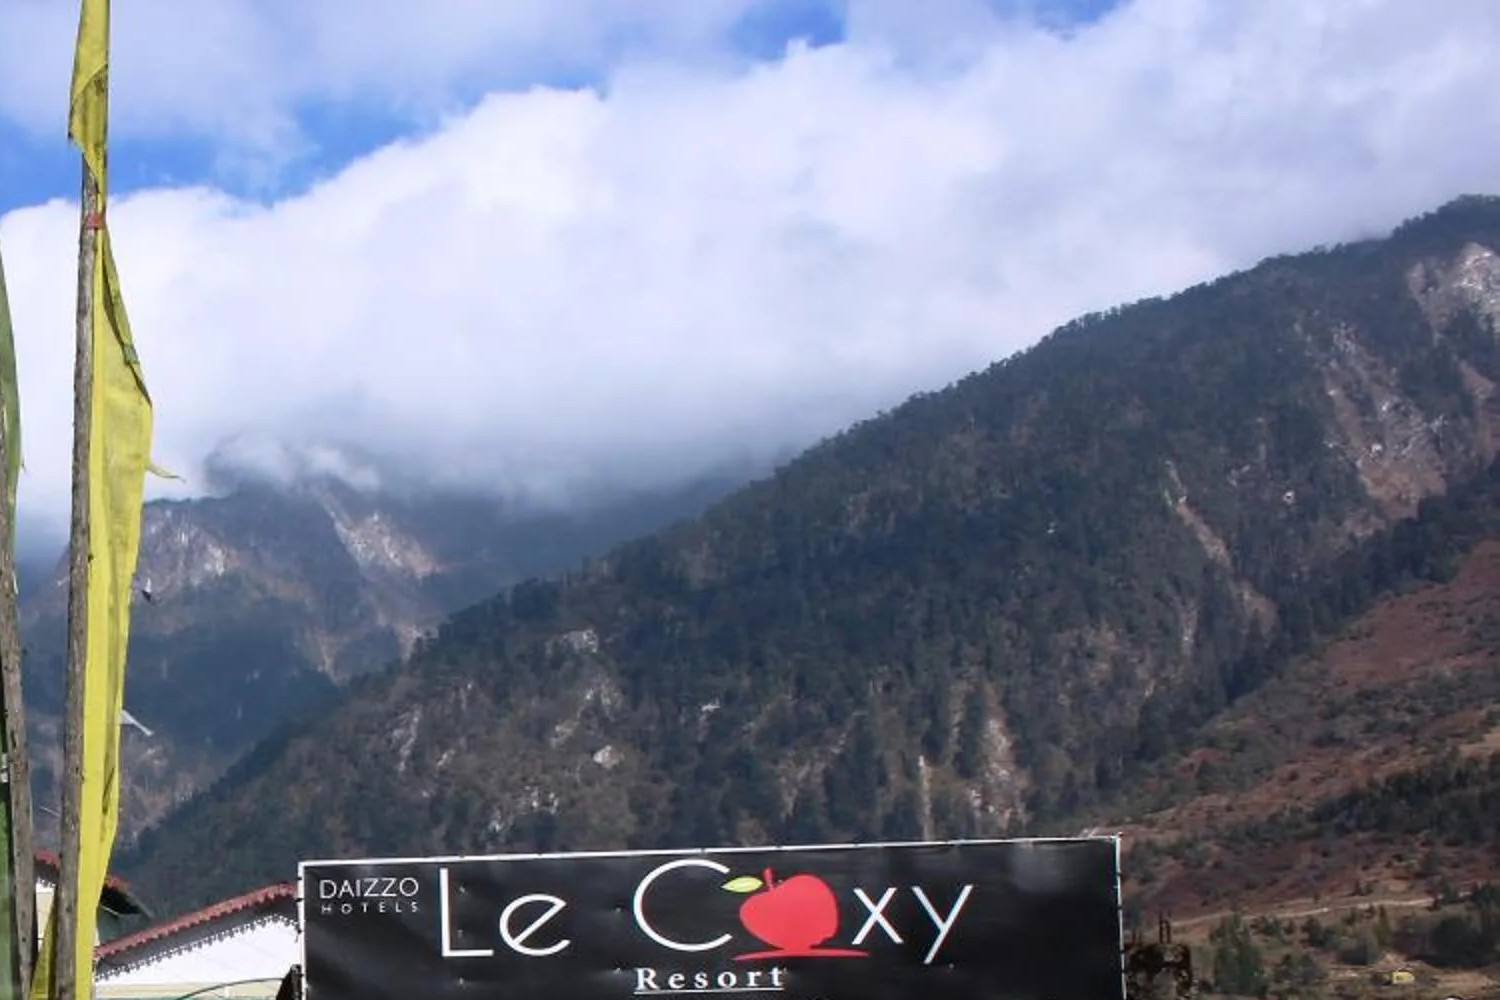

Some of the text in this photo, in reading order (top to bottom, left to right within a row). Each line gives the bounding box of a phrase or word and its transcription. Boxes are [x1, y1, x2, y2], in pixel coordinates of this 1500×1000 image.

[319, 877, 419, 899] DAIZZO
[321, 902, 419, 914] HOTELS
[440, 868, 570, 957] Le
[634, 967, 784, 990] Resort
